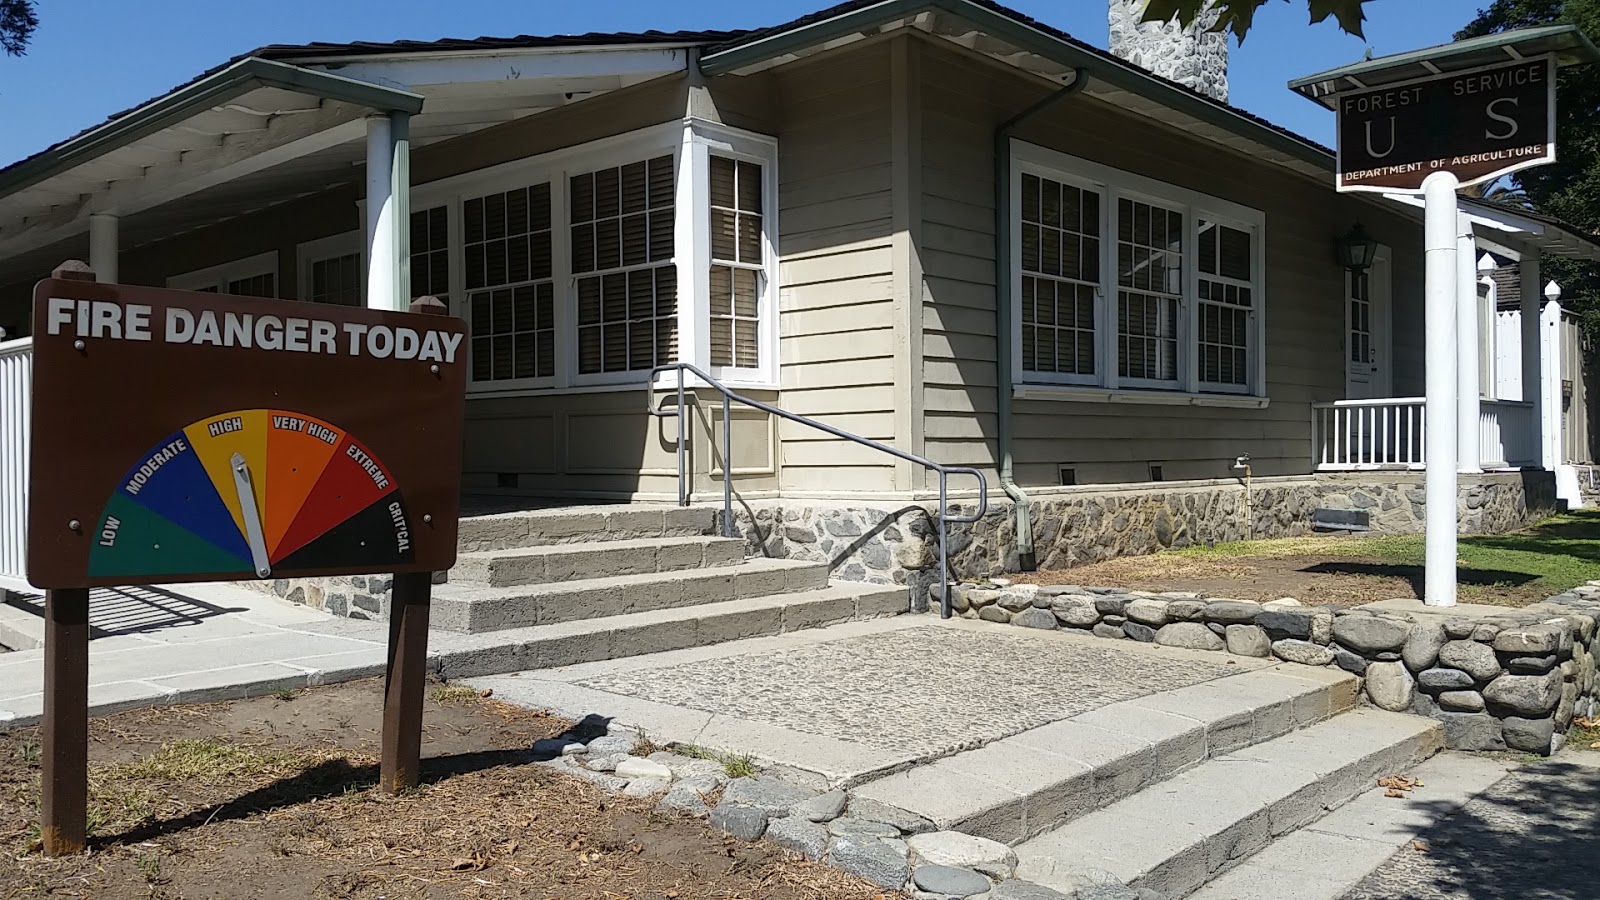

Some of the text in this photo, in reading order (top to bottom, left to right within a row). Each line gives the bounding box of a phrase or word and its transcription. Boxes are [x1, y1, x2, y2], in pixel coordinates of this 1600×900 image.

[1344, 65, 1542, 115] FOREST SERVICE
[1364, 97, 1519, 158] U S
[1345, 143, 1542, 181] DEPARTMENT OF AGRICULTURE
[47, 298, 463, 364] FIRE DANGER TODAY
[208, 416, 243, 437] HIGH
[273, 416, 339, 445] VERY HIGH
[125, 438, 188, 495] MODERATE
[345, 443, 390, 491] EXTREME
[99, 515, 122, 547] LOW
